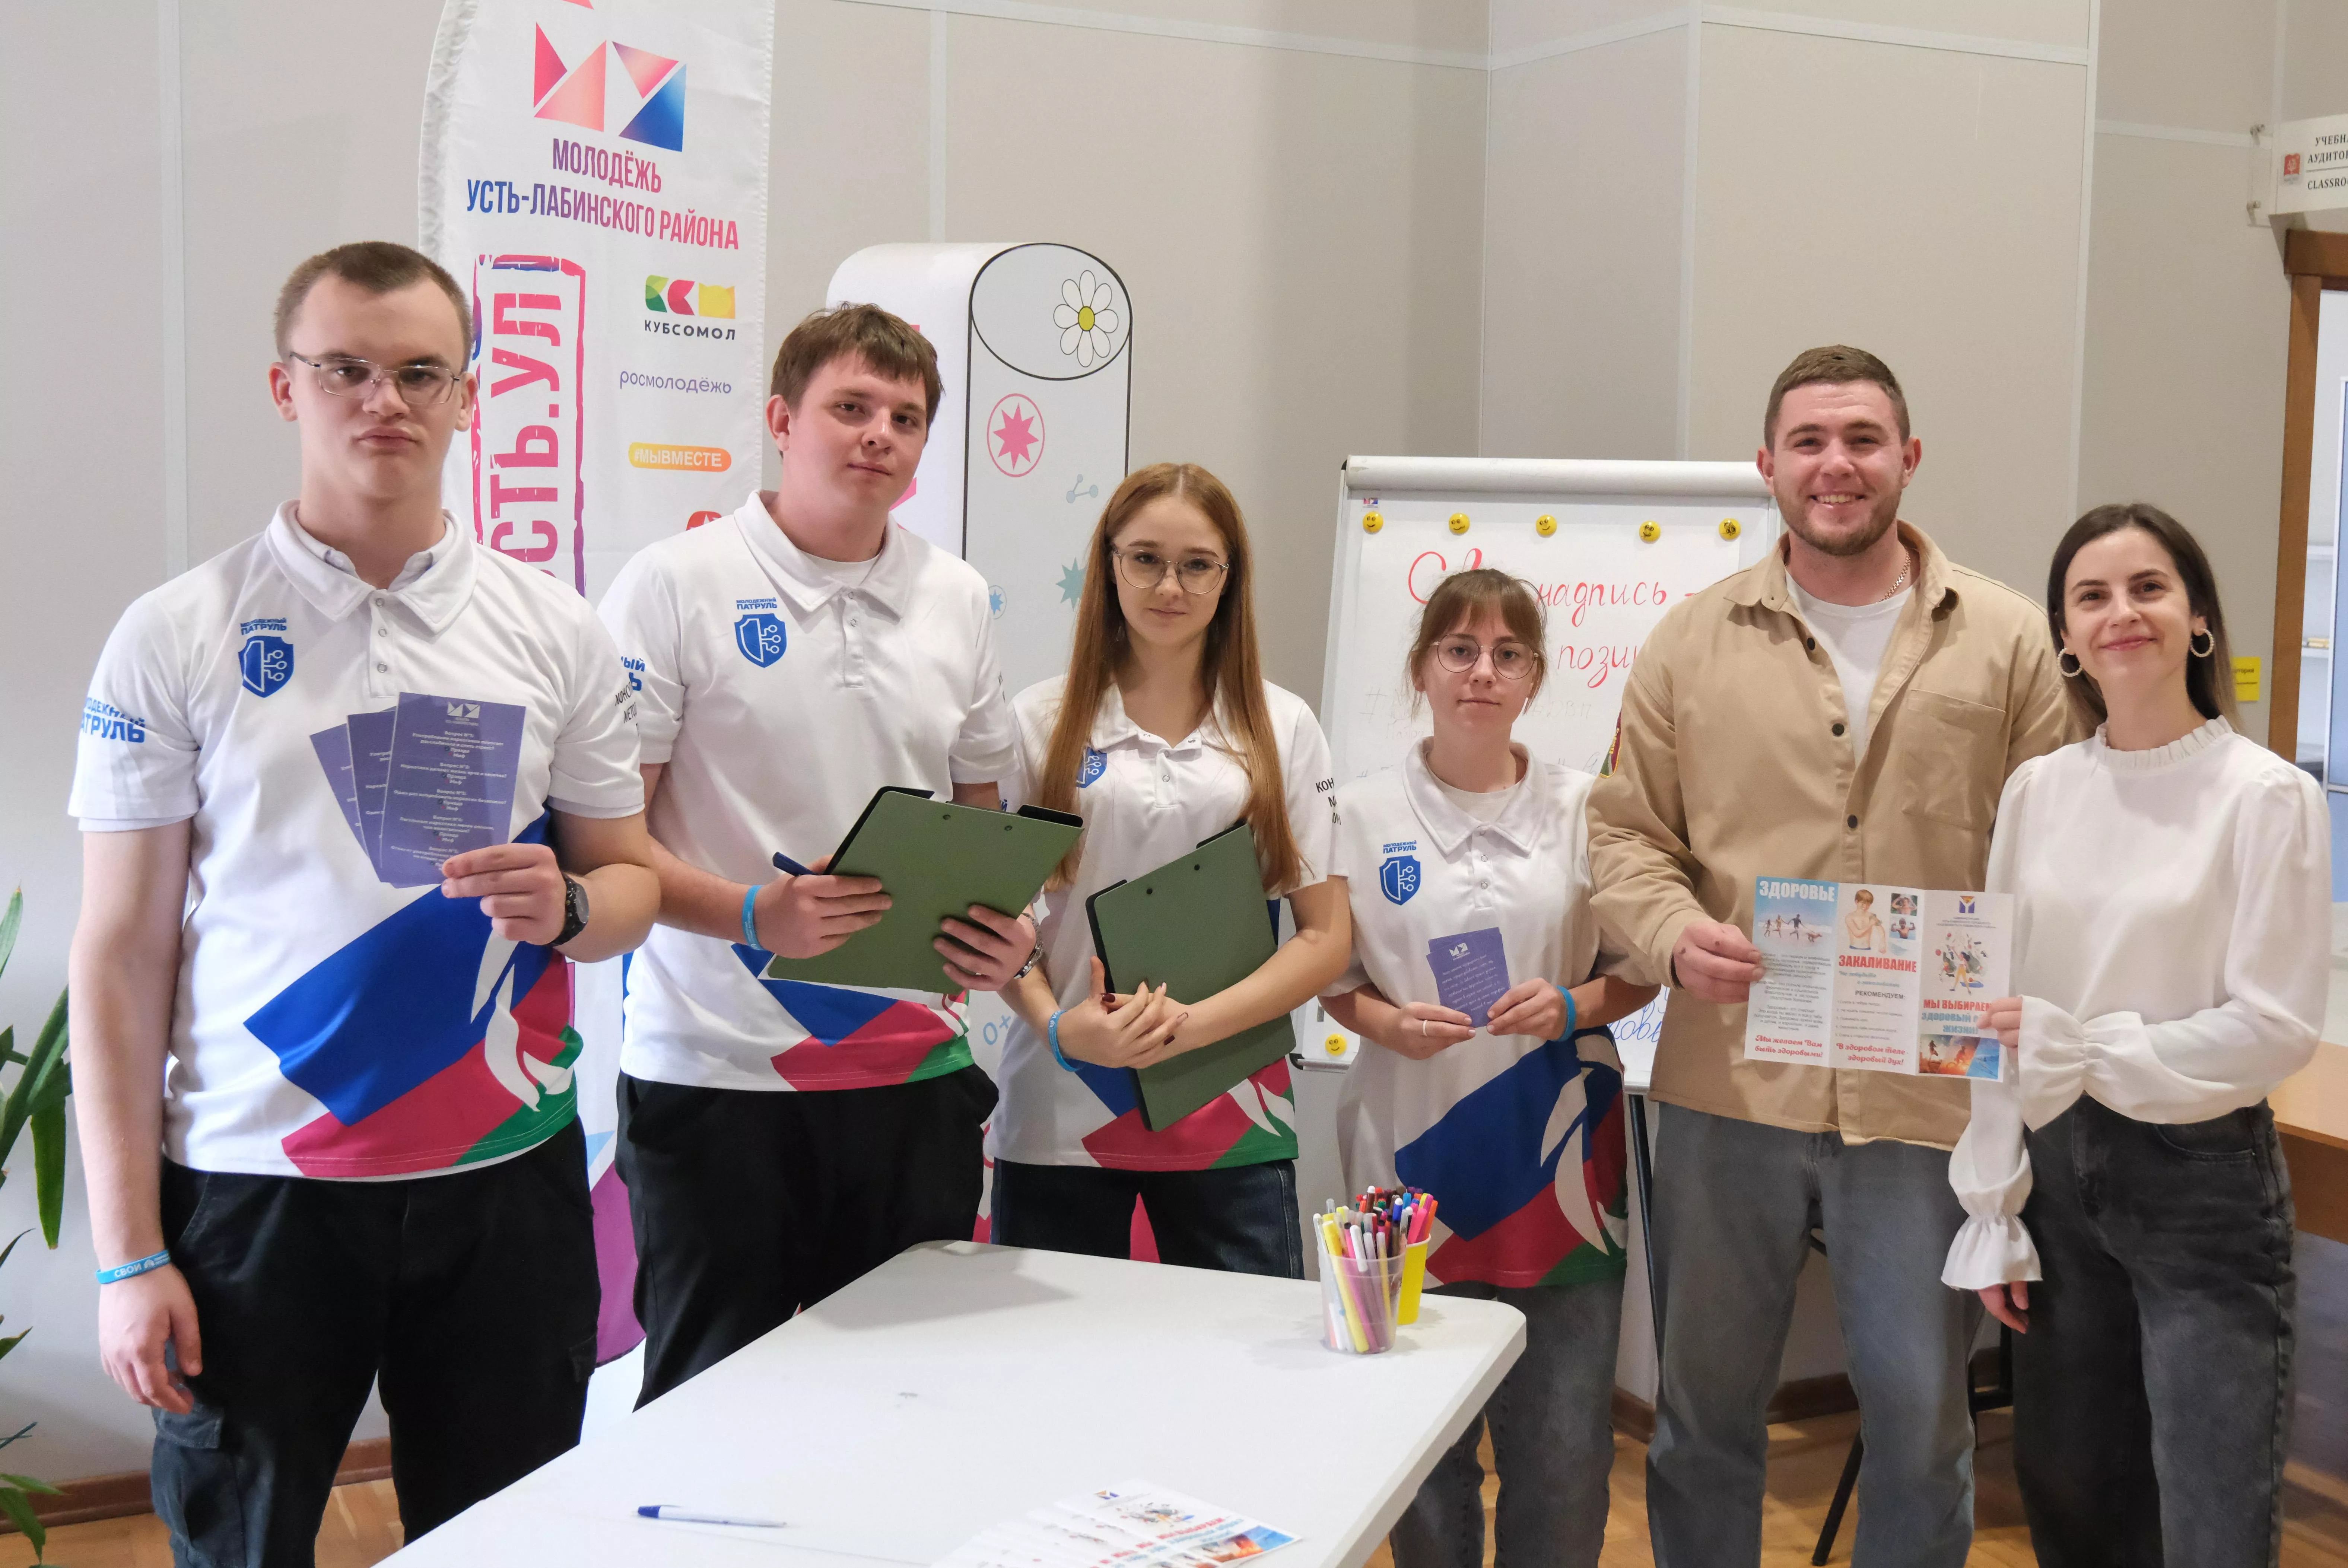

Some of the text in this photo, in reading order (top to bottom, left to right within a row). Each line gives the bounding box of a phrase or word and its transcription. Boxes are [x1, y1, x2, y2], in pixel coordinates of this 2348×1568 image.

[2315, 133, 2348, 146] УЧЕБН
[553, 138, 662, 193] МОЛОДЁЖЬ
[2307, 176, 2348, 190] CLASSRO
[467, 179, 739, 250] УСТЬ-ЛАБИНСКОГО РАЙОНА
[644, 319, 735, 341] КУБСОМОЛ
[620, 371, 732, 394] росмолодёжь
[634, 450, 722, 467] #МЫВМЕСТЕ
[241, 623, 287, 635] ПАТРУЛЬ
[1383, 845, 1416, 854] ПАТРУЛЬ
[1759, 880, 1835, 902] ЗДОРОВЬЕ
[1839, 955, 1917, 973] ЗАКАЛИВАНИЕ
[1855, 990, 1906, 999] РЕКОМЕНДУЕМ:
[1923, 999, 1940, 1009] МЫ
